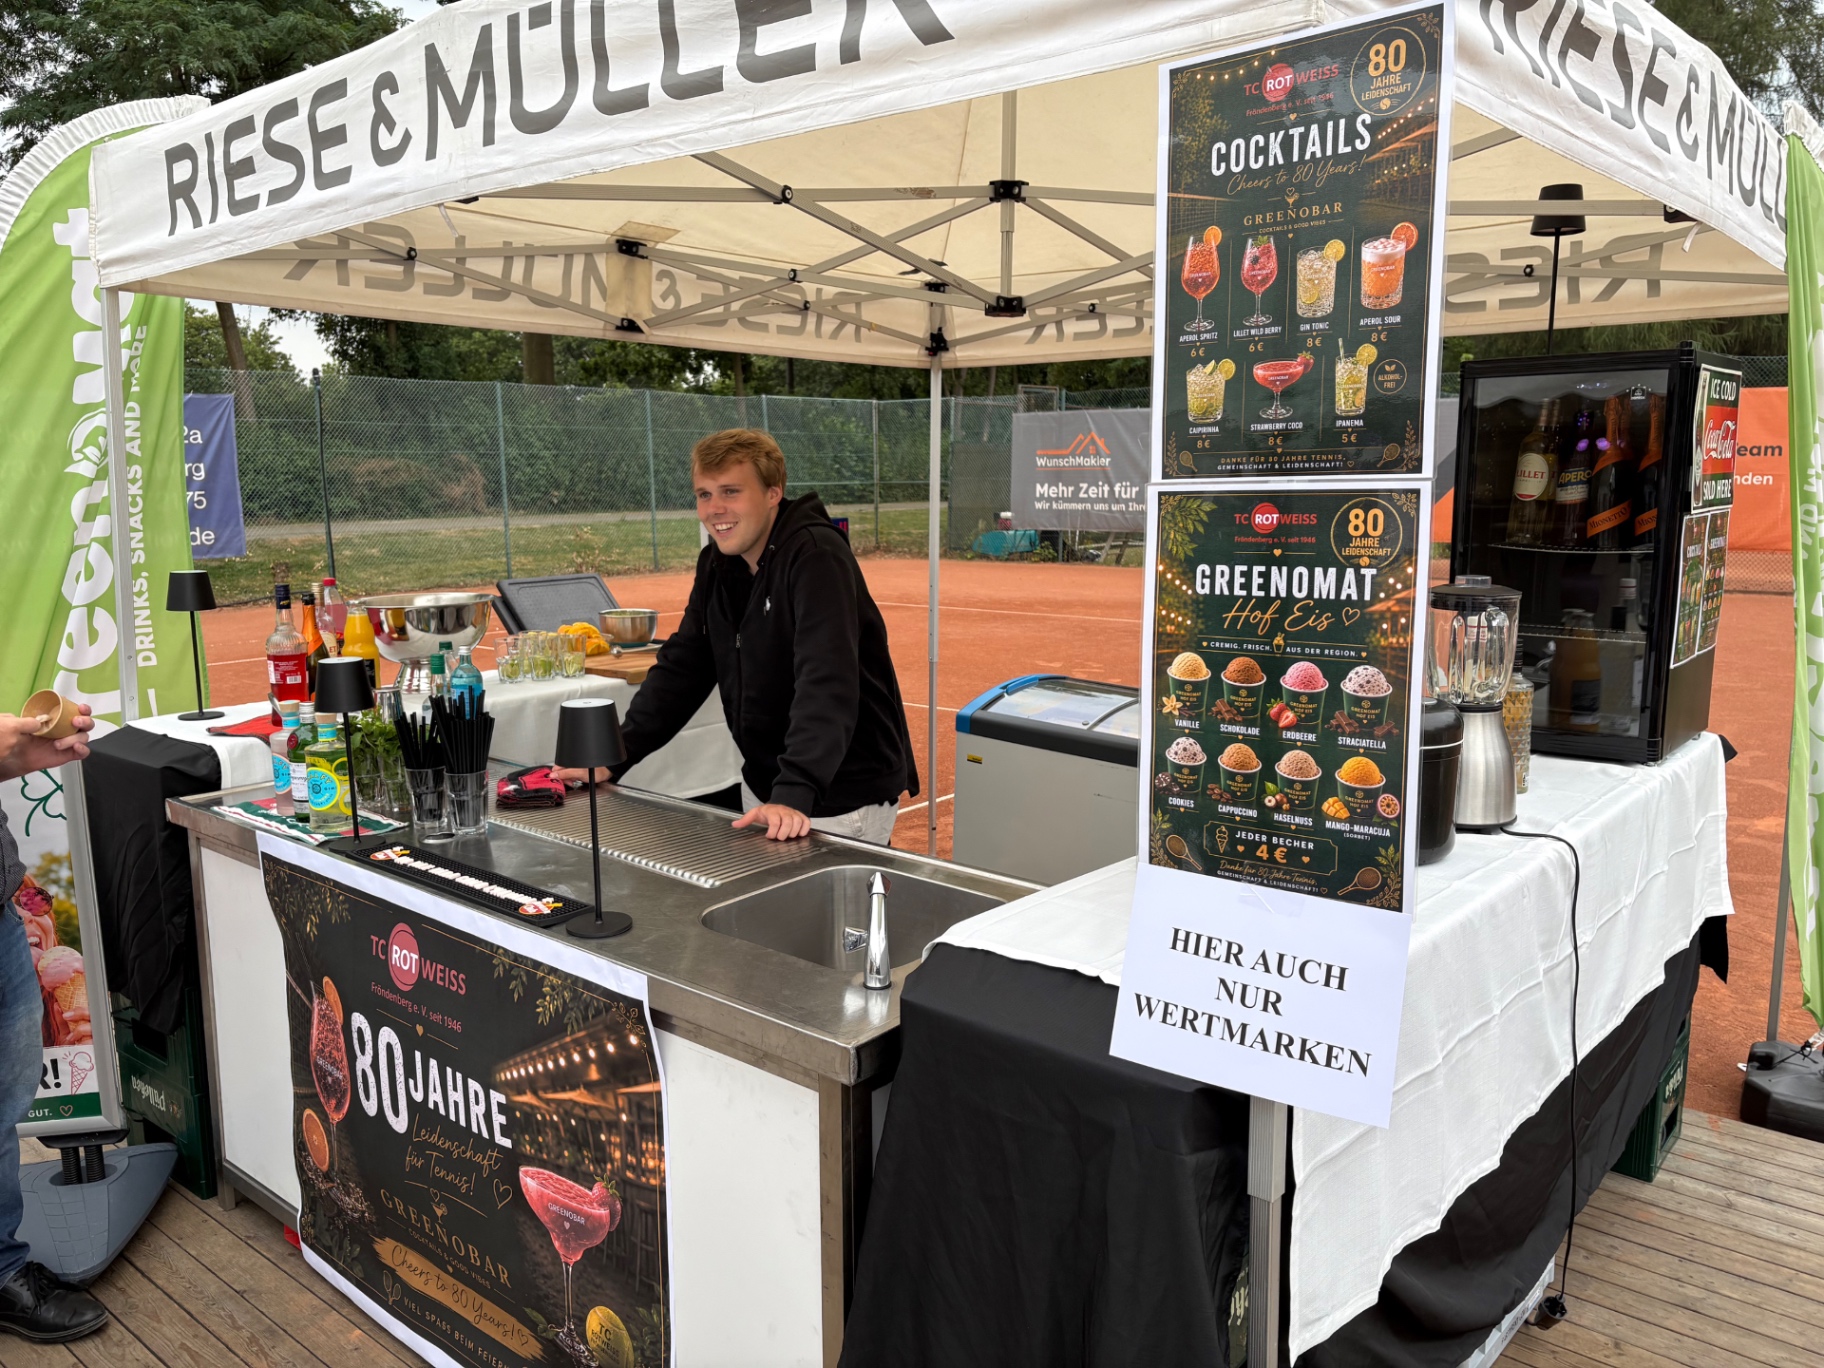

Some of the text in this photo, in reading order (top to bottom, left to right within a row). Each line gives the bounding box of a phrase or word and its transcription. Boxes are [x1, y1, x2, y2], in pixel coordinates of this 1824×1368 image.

[1368, 38, 1407, 77] 80
[1243, 63, 1340, 96] TC ROT WEISS
[1370, 72, 1402, 90] JAHRE
[1361, 82, 1412, 101] LEIDENSCHAFT
[1211, 113, 1372, 177] COCKTAILS
[1676, 63, 1700, 162] &
[1707, 70, 1788, 235] MÜLL
[165, 78, 352, 236] RIESE
[371, 71, 412, 167] &
[1226, 153, 1367, 195] Cheers to 80 Years!
[1243, 201, 1343, 227] GREENOBAR
[1259, 224, 1288, 234] COCKTAILS
[1294, 221, 1310, 229] GOOD
[1300, 321, 1329, 331] GIN TONIC
[1360, 315, 1401, 326] APEROL SOUR
[1179, 332, 1218, 343] APEROL SPRITZ
[1233, 326, 1282, 337] LILLET WILD BERRY
[1371, 331, 1388, 343] 8 €
[1248, 342, 1264, 353] 6 €
[1306, 337, 1322, 347] 8 €
[1190, 347, 1206, 357] 6 €
[1377, 373, 1403, 381] ALKOHOL-
[1383, 381, 1396, 389] FREI
[1710, 377, 1737, 401] ICE COLD
[125, 401, 142, 457] AND
[1189, 426, 1219, 434] CAIPIRINHA
[1250, 421, 1304, 431] STRAWBERRY COCO
[1335, 419, 1364, 428] IPANEMA
[1196, 439, 1211, 449] 8 €
[1268, 436, 1283, 446] 8 €
[1341, 433, 1358, 443] 5 €
[1736, 444, 1783, 457] eam
[1036, 455, 1111, 468] WunschMakler
[1217, 461, 1343, 471] GEMEINSCHAFT LEIDENSCHAFT!
[1250, 455, 1265, 463] FÜR
[1558, 469, 1593, 485] APERO
[1035, 481, 1140, 499] Mehr Zeit für
[1703, 478, 1732, 501] SOLD HERE
[127, 464, 147, 564] SNACKS
[1034, 501, 1049, 511] Wir
[1053, 501, 1091, 511] kümmern
[1093, 502, 1109, 511] uns
[1112, 502, 1126, 512] um
[1234, 513, 1318, 525] TC ROT WEISS
[1347, 507, 1385, 537] 80
[1637, 514, 1658, 529] MION
[1300, 536, 1316, 544] 1946
[1349, 537, 1380, 547] JAHRE
[1342, 547, 1392, 556] LEIDENSCHAFT
[1195, 563, 1378, 601] GREENOMAT
[133, 571, 158, 667] DRINKS,
[1222, 598, 1336, 636] Hof Eis
[1210, 641, 1241, 650] CREMIG.
[1243, 643, 1273, 652] FRISCH.
[1305, 647, 1321, 655] DER
[1324, 649, 1358, 657] REGION.
[1174, 719, 1200, 729] VANILLE
[1219, 723, 1260, 736] SCHOKOLADE
[1282, 730, 1317, 742] ERDBEERE
[1337, 736, 1387, 750] STRACIATELLA
[1168, 796, 1195, 808] COOKIES
[1218, 804, 1258, 818] CAPPUCCINO
[1273, 812, 1313, 827] HASELNUSS
[1325, 820, 1391, 837] MANGO-MARACUJA
[1235, 830, 1315, 850] JEDER BECHER
[1343, 832, 1371, 841] (SORBET)
[1255, 844, 1288, 864] 4 €
[1217, 870, 1262, 882] GEMEINSCHAFT
[1220, 860, 1243, 871] Danke
[1268, 869, 1292, 880] Jahre
[370, 934, 467, 996] TC ROT WEISS
[1169, 927, 1349, 991] HIER AUCH
[1214, 976, 1283, 1017] NUR
[370, 981, 462, 1033] Fröndenberg V. seit 1946
[1134, 992, 1372, 1078] WERTMARKEN
[351, 1011, 513, 1149] 80 JAHRE
[28, 1108, 53, 1118] GUT.
[412, 1113, 504, 1178] Leidenschaft
[404, 1145, 476, 1196] für Tennis!
[548, 1202, 586, 1225] GREENOBAR
[380, 1188, 512, 1289] GREENOBAR
[408, 1227, 491, 1289] COCKTAILS GOOD VIBES
[391, 1244, 516, 1340] Cheers to 80 Years!
[404, 1296, 422, 1316] VIEL
[425, 1311, 451, 1334] SPASS
[454, 1330, 475, 1351] BEIM
